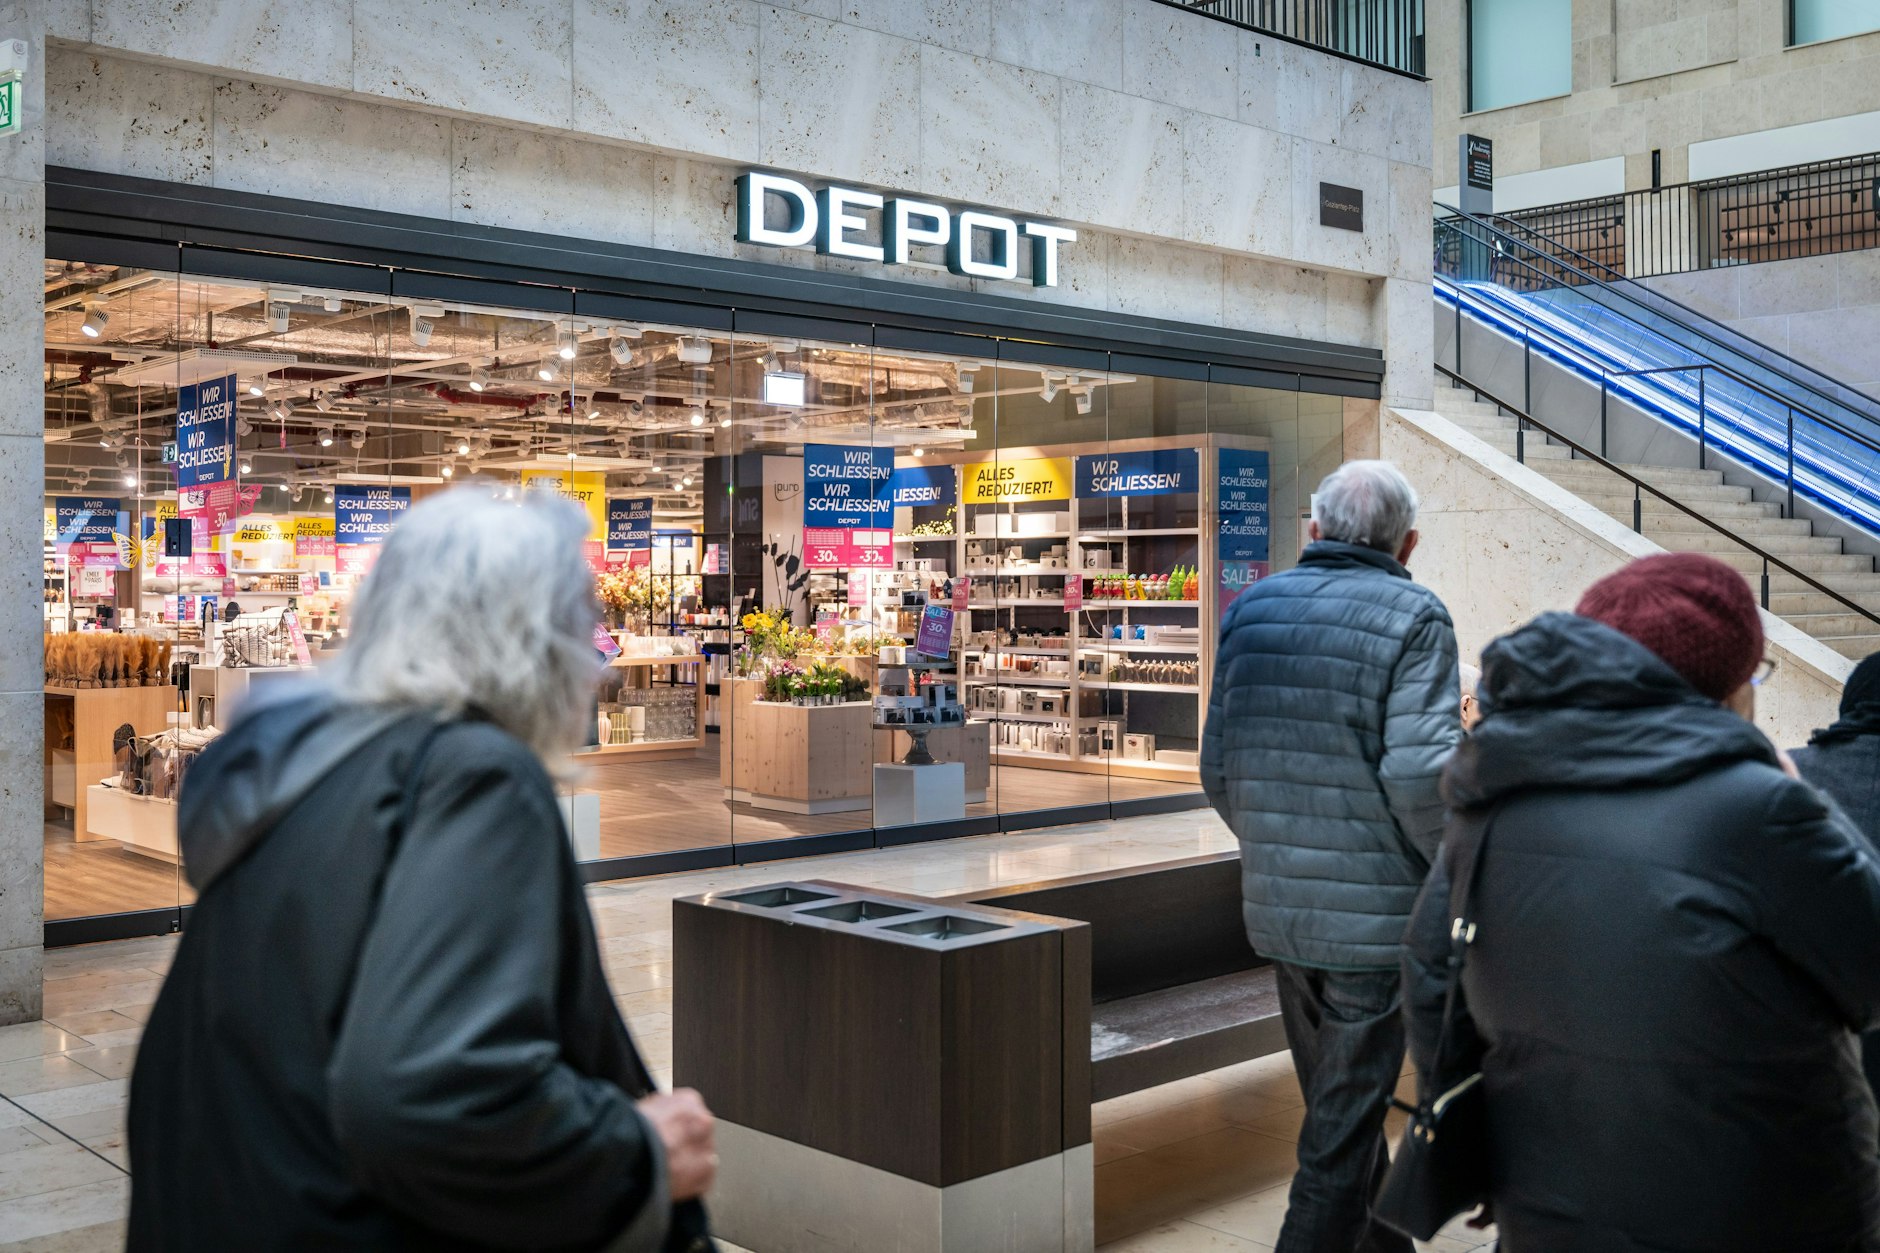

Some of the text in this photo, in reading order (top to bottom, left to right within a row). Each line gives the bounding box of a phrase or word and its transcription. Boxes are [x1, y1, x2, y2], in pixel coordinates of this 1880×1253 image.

[741, 172, 1077, 288] DEPOT
[202, 386, 220, 404] WIR
[179, 401, 233, 428] SCHLIESSEN!
[187, 431, 205, 449] WIR
[178, 444, 233, 469] SCHLIESSEN!
[844, 451, 870, 465] WIR
[808, 464, 890, 480] SCHLIESSEN!
[1091, 460, 1119, 475] WIR
[1238, 468, 1254, 476] WIR
[199, 473, 214, 481] DEPOT
[977, 467, 1014, 482] ALLES
[526, 477, 563, 488] ALLES
[774, 480, 801, 494] ipuro
[1091, 473, 1180, 492] SCHLIESSEN!
[1220, 476, 1267, 488] SCHLIESSEN!
[823, 483, 850, 497] WIR
[893, 487, 941, 501] LIESSEN!
[977, 480, 1053, 497] REDUZIERT!
[367, 490, 390, 500] WIR
[1230, 491, 1246, 500] WIR
[160, 506, 178, 514] ALL
[338, 500, 408, 510] SCHLIESSEN!
[630, 502, 644, 510] WIR
[808, 498, 890, 512] SCHLIESSEN!
[1220, 501, 1267, 512] SCHLIESSEN!
[59, 508, 117, 516] SCHLIESSEN!
[350, 513, 373, 522] WIR
[611, 510, 651, 520] SCHLIESSEN!
[69, 518, 88, 526] WIR
[1244, 516, 1260, 525] WIR
[59, 525, 117, 534] SCHLIESSEN!
[242, 524, 273, 532] ALLES
[339, 523, 398, 533] SCHLIESSE
[618, 522, 633, 531] WIR
[1220, 525, 1267, 536] SCHLIESSEN!
[609, 530, 650, 540] SCHLIESSEN!
[814, 550, 838, 562] -30%
[860, 550, 884, 562] -30%
[200, 566, 219, 575] -30%
[1221, 568, 1258, 585] SALE!
[925, 606, 948, 619] SALE!
[926, 622, 947, 634] -30%
